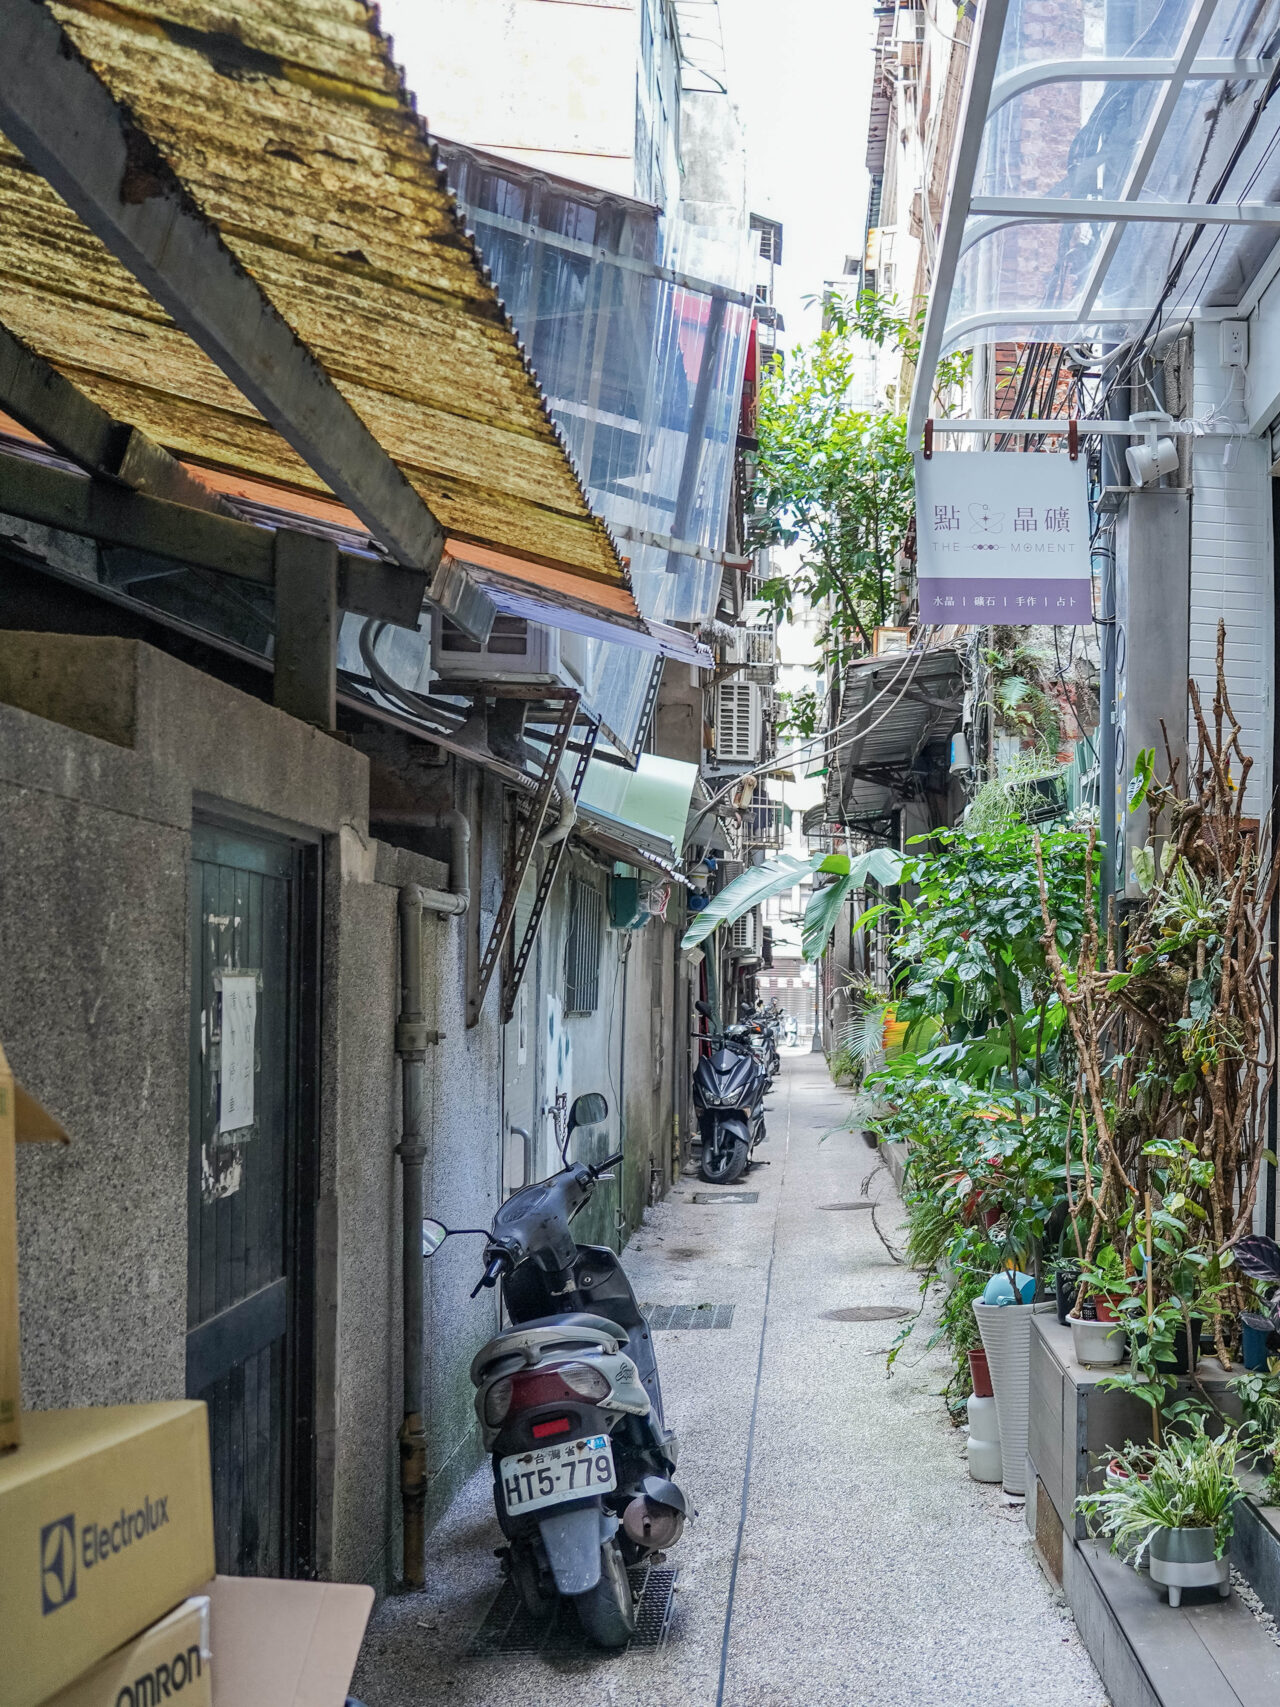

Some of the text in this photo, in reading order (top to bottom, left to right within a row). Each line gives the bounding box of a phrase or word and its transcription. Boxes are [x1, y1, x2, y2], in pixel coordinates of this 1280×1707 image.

[934, 505, 1070, 533] 點 晶礦
[932, 542, 1076, 553] THE MOMENT
[933, 596, 955, 607] 水晶
[1016, 596, 1037, 607] 手作
[534, 1446, 575, 1464] 台灣省
[504, 1455, 612, 1506] HT5-779
[82, 1495, 170, 1570] Electrolux
